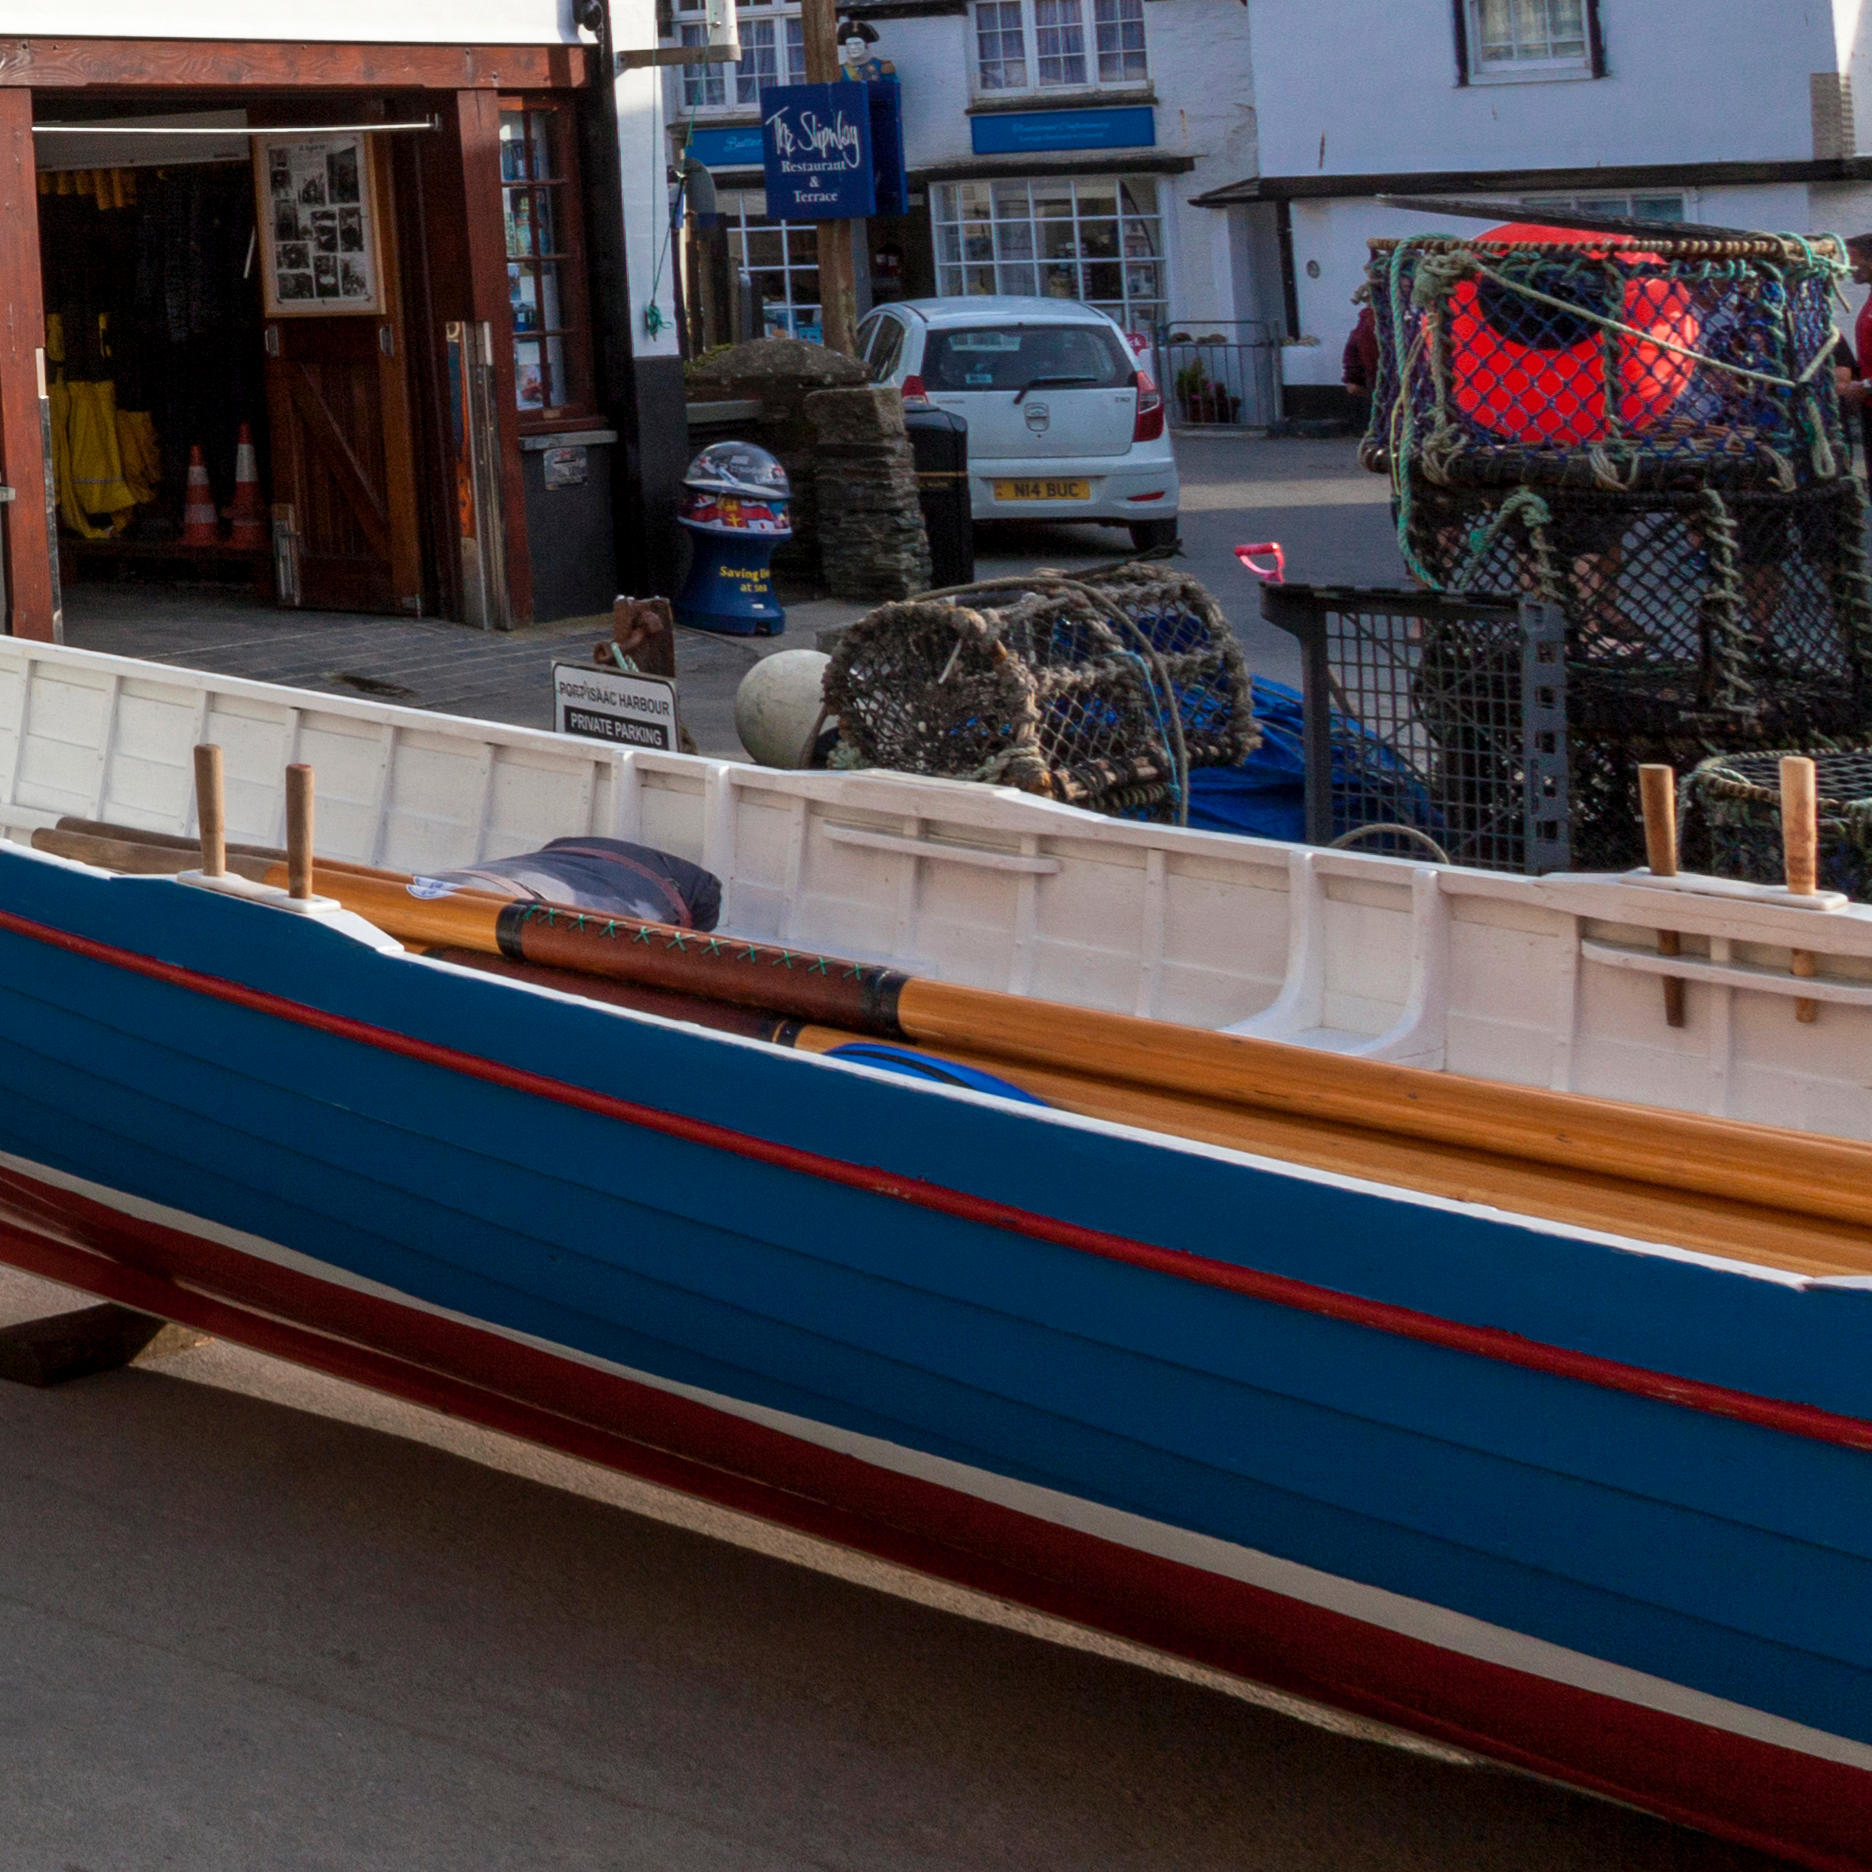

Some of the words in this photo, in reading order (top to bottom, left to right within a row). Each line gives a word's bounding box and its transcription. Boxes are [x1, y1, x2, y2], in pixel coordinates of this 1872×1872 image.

[781, 160, 847, 173] Restaurant
[809, 176, 820, 188] &
[793, 190, 838, 202] Terrace
[1047, 482, 1079, 497] BUC
[720, 566, 759, 581] Saving
[740, 583, 752, 592] at
[586, 685, 617, 706] ISAAC
[619, 693, 670, 716] HARBOUR
[570, 712, 613, 735] PRIVATE
[615, 722, 662, 746] PARKING
